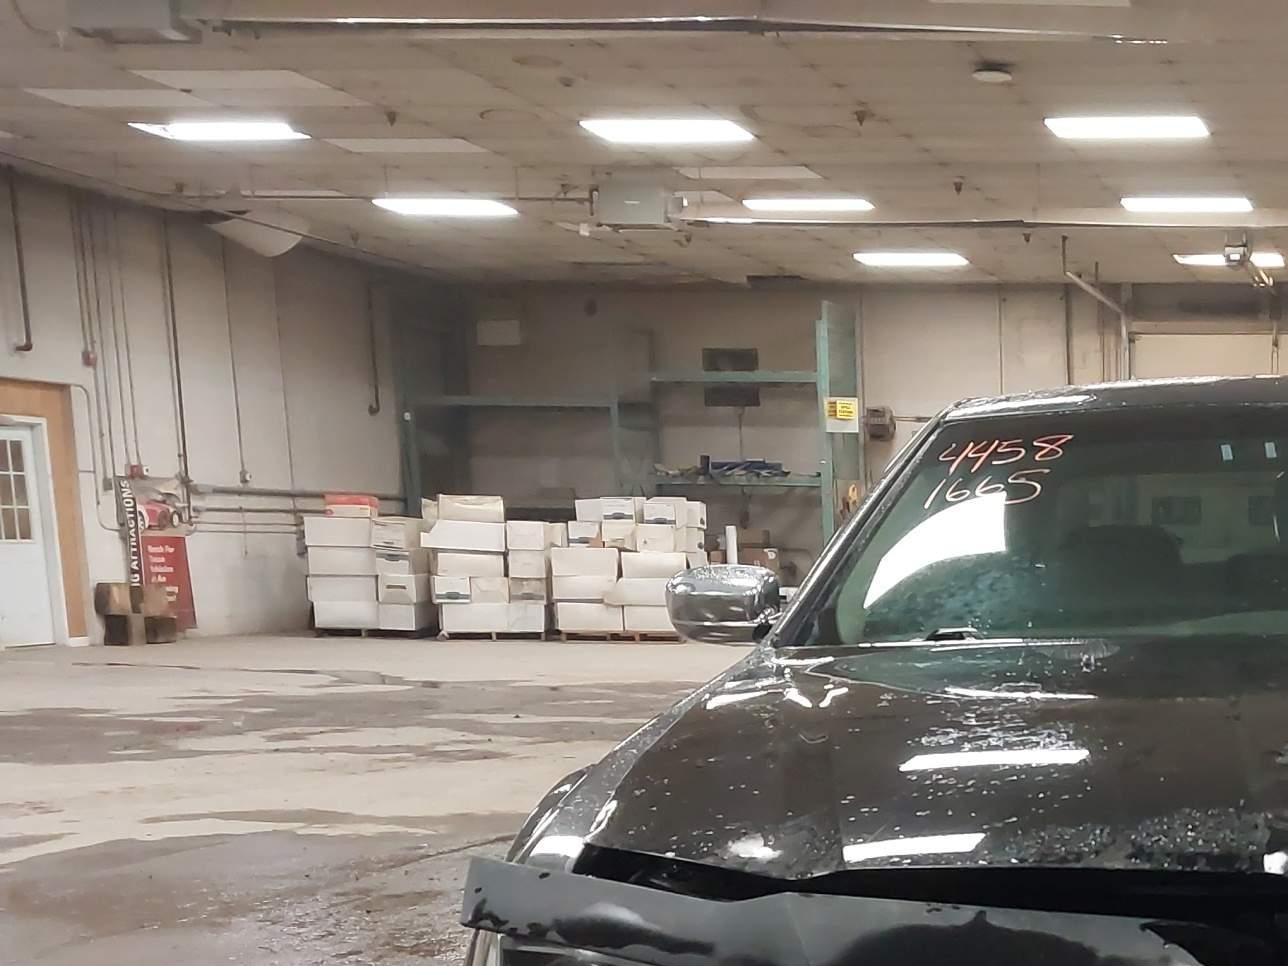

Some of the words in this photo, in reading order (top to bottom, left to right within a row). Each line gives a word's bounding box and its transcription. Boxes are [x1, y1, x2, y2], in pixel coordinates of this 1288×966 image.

[938, 434, 1074, 475] 4458
[924, 468, 1051, 509] 1665
[120, 479, 142, 570] ATTRACTIONS
